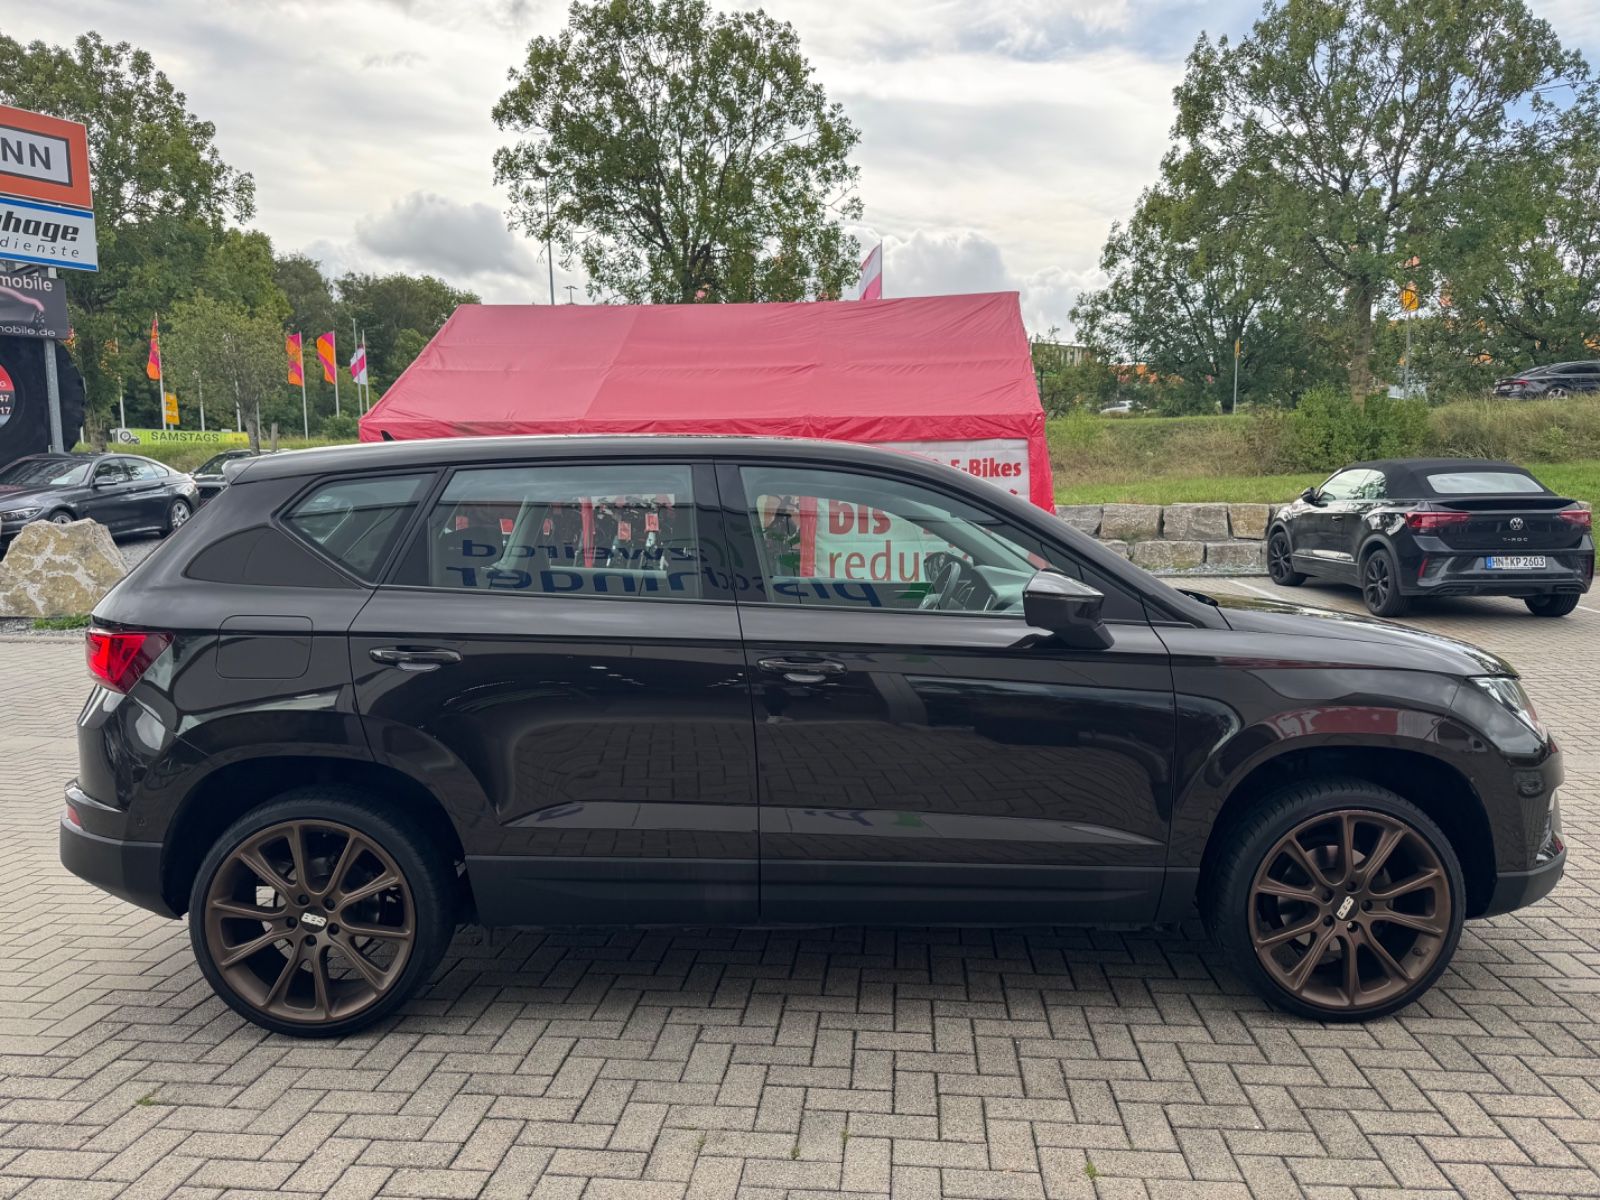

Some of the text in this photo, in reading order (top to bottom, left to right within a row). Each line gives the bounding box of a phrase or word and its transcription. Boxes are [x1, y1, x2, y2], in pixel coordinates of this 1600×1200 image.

[0, 210, 79, 243] hage
[0, 236, 79, 258] dienste
[150, 431, 220, 443] SAMSTAGS
[828, 539, 938, 583] redu
[1510, 556, 1521, 567] KP
[1523, 556, 1545, 567] 2603
